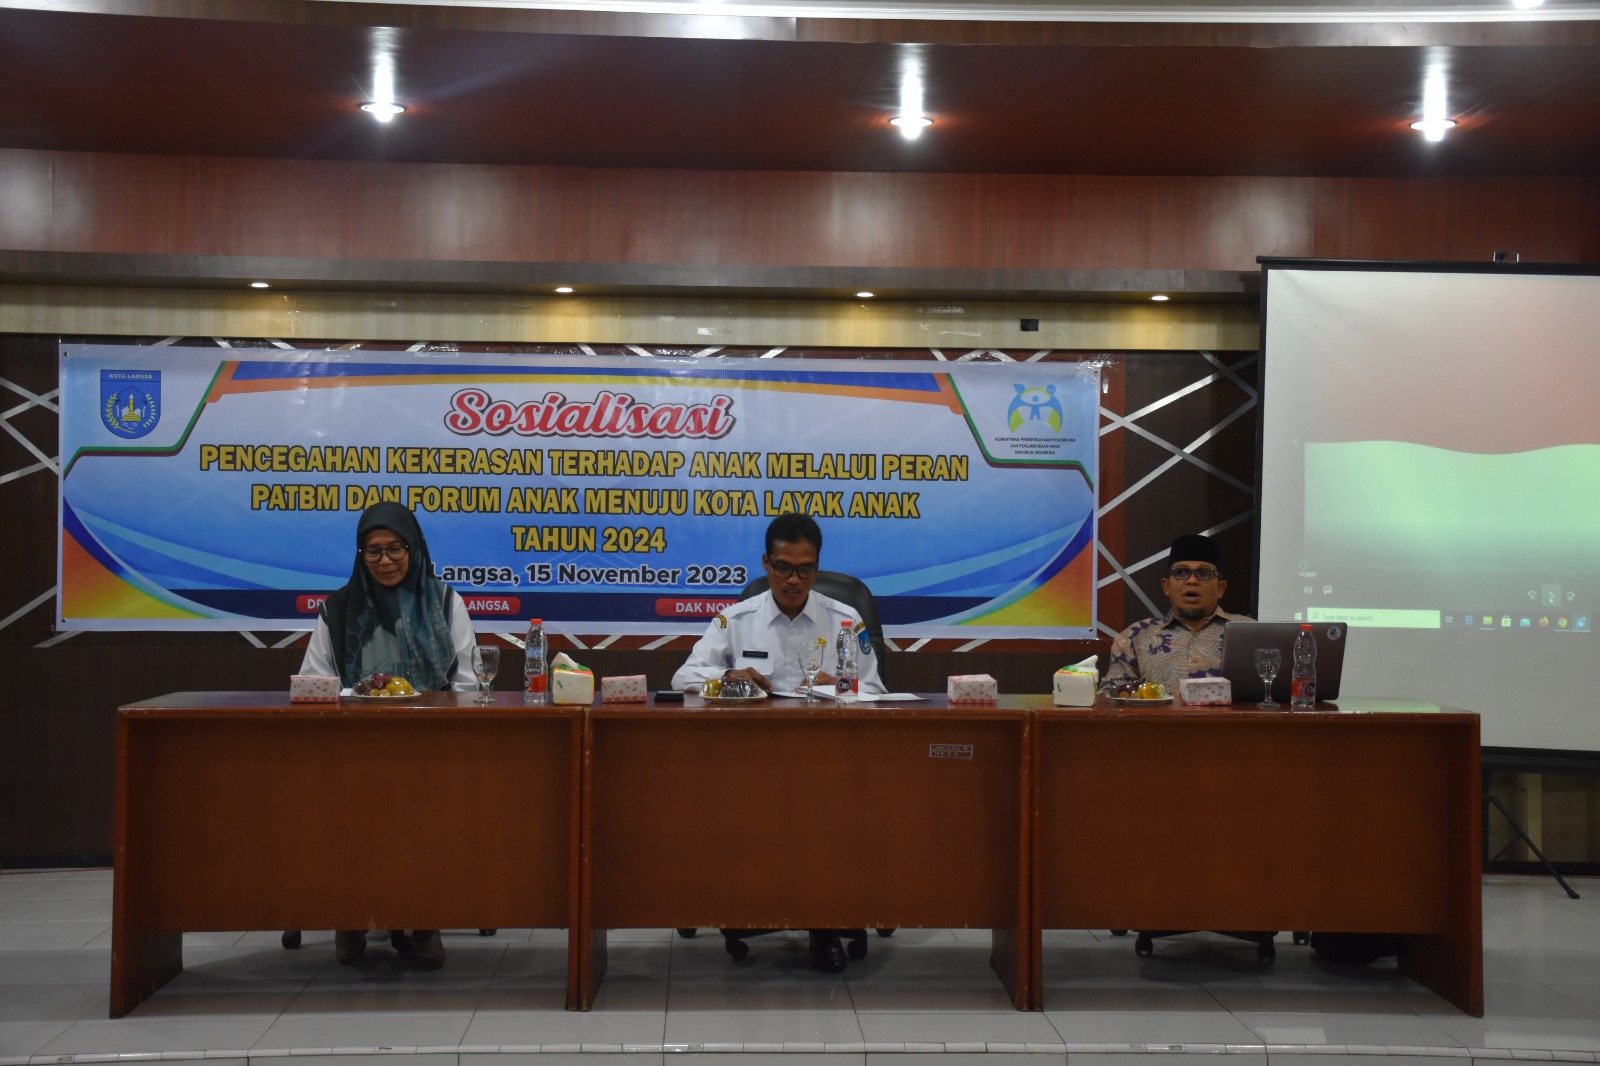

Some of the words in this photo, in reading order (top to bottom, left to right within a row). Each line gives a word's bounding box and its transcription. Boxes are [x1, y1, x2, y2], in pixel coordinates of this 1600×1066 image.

[446, 389, 735, 438] Sosialisasi
[200, 444, 380, 473] PENCEGAHAN
[386, 446, 543, 475] KEKERASAN
[548, 449, 685, 477] TERHADAP
[689, 452, 762, 478] ANAK
[766, 453, 876, 480] MELALUI
[882, 454, 969, 481] PERAN
[251, 484, 340, 511] PATBM
[346, 485, 400, 511] DAN
[407, 486, 501, 513] FORUM
[506, 487, 579, 514] ANAK
[584, 488, 687, 515] MENUJU
[693, 489, 759, 516] KOTA
[764, 490, 844, 517] LAYAK
[848, 492, 921, 518] ANAK
[511, 526, 596, 552] TAHUN
[602, 527, 667, 553] 2024
[429, 562, 520, 586] Langsa,
[526, 563, 551, 583] 15
[558, 564, 681, 585] November
[686, 565, 747, 585] 2023
[675, 602, 703, 613] DAK
[1323, 613, 1335, 621] Type
